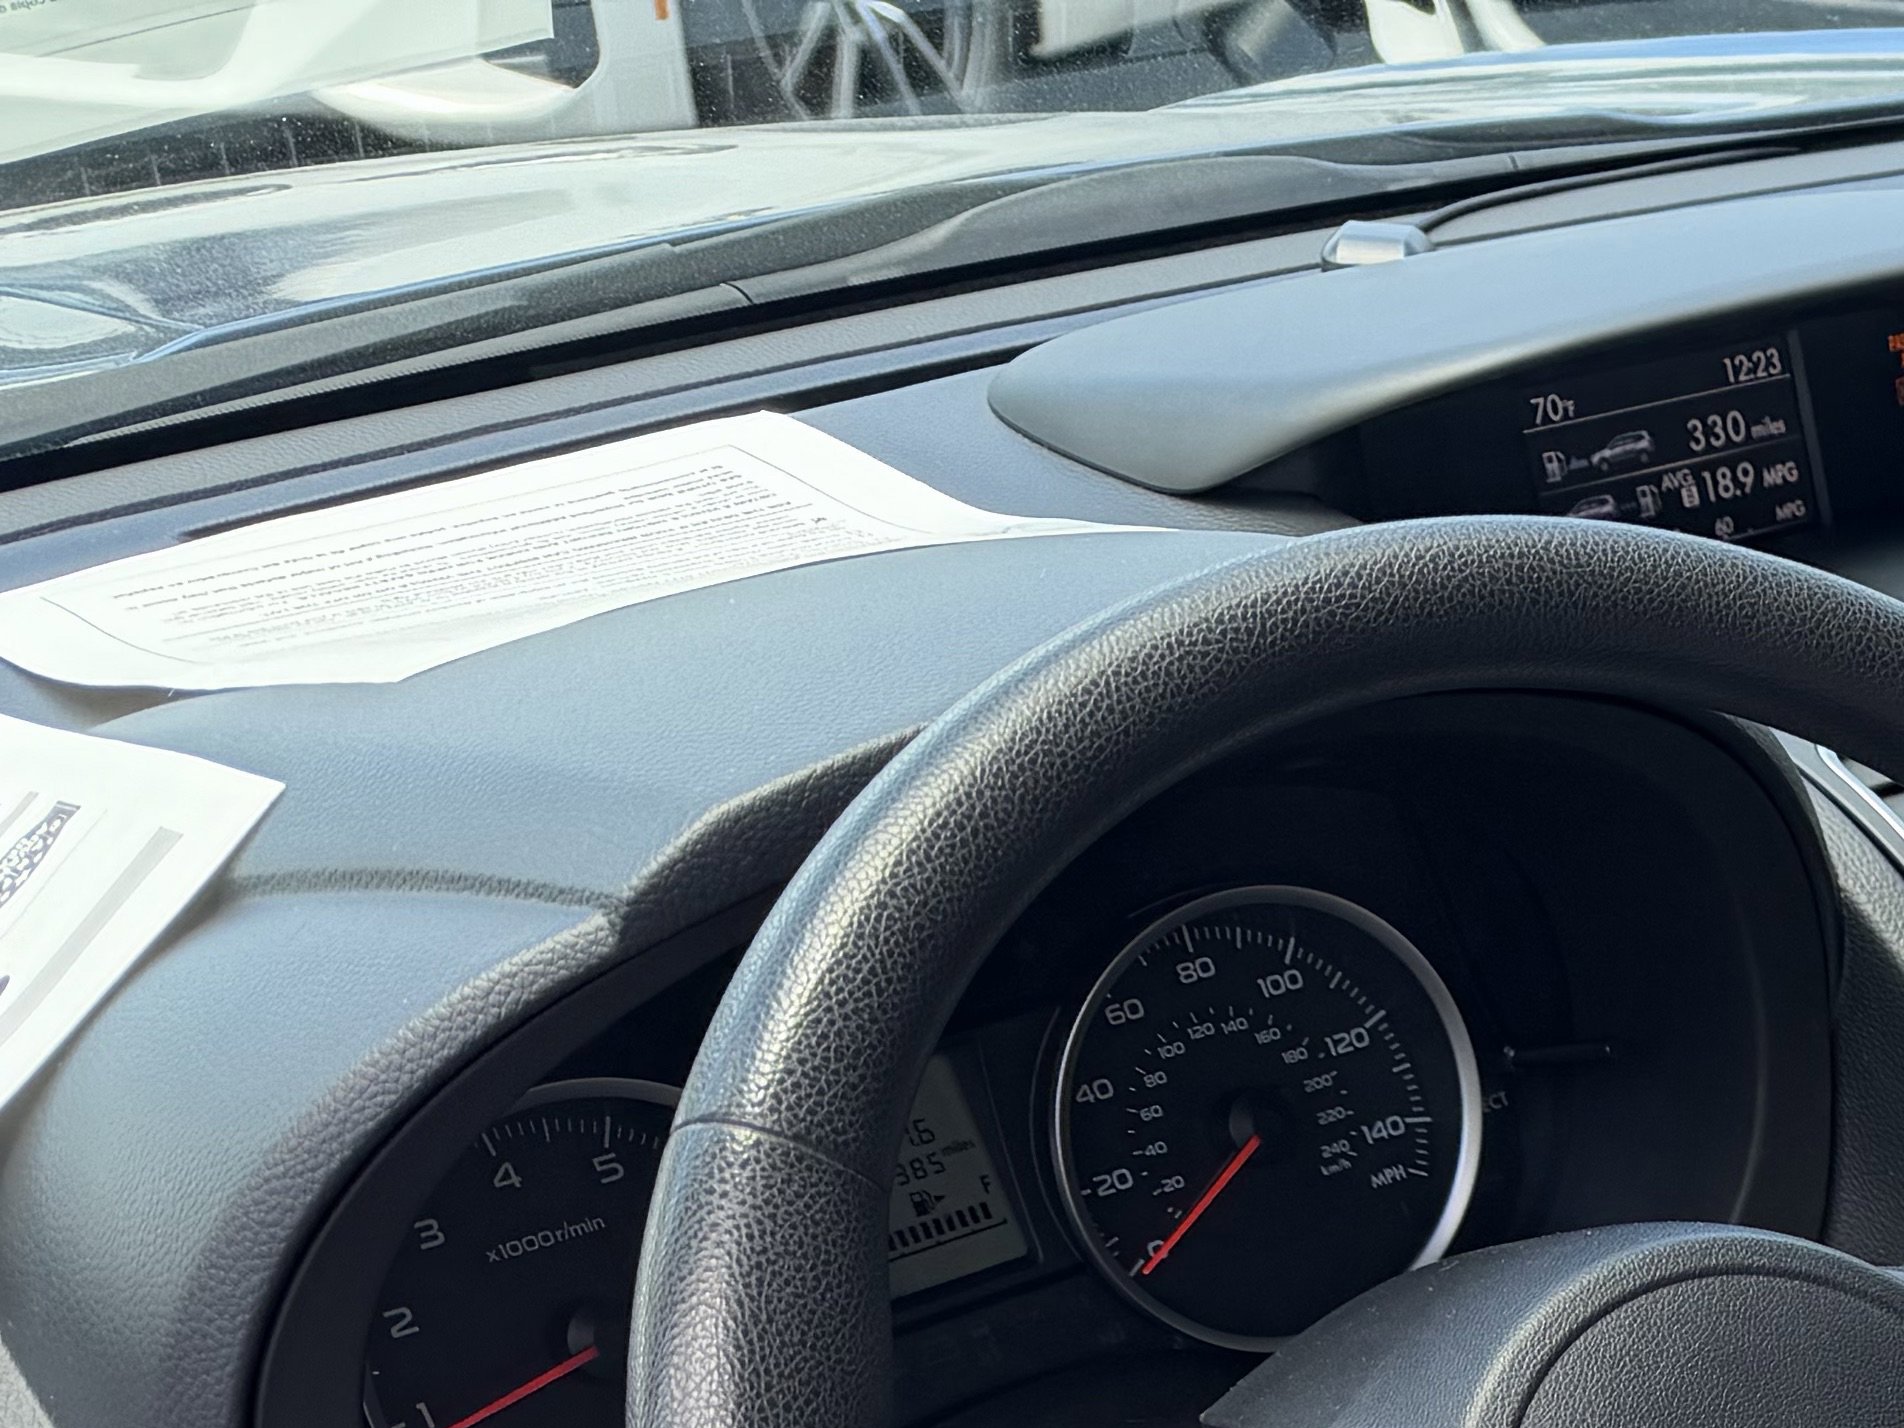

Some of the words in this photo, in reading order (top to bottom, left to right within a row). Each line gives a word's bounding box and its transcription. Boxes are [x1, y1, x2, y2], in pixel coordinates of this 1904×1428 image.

[1722, 348, 1782, 383] 12:23
[1687, 410, 1745, 452] 330
[1751, 415, 1786, 440] miles
[1661, 469, 1693, 493] AVG
[1702, 461, 1754, 503] 18.9
[1762, 461, 1799, 488] MPG
[1775, 500, 1806, 522] MPG
[1176, 956, 1216, 984] 80
[1257, 968, 1304, 998] 100
[1105, 998, 1145, 1026] 60
[1187, 1020, 1215, 1041] 120
[1221, 1015, 1249, 1035] 140
[1254, 1025, 1281, 1046] 160
[1157, 1040, 1186, 1061] 100
[1327, 1025, 1370, 1057] 120
[1281, 1045, 1309, 1065] 180
[1075, 1077, 1114, 1104] 40
[1143, 1069, 1168, 1089] 80
[1303, 1073, 1334, 1093] 200
[1139, 1103, 1164, 1122] 60
[1316, 1106, 1346, 1126] 220
[1361, 1115, 1406, 1146] 140
[1145, 1140, 1168, 1158] 40
[1320, 1138, 1351, 1159] 240
[493, 1161, 522, 1189] 4
[593, 1152, 626, 1185] 5
[1319, 1157, 1353, 1177] km/h
[1370, 1165, 1407, 1189] MPH
[980, 1174, 991, 1194] F
[1093, 1168, 1134, 1198] 20
[1161, 1175, 1185, 1193] 20
[413, 1218, 445, 1251] 3
[383, 1306, 420, 1339] 2
